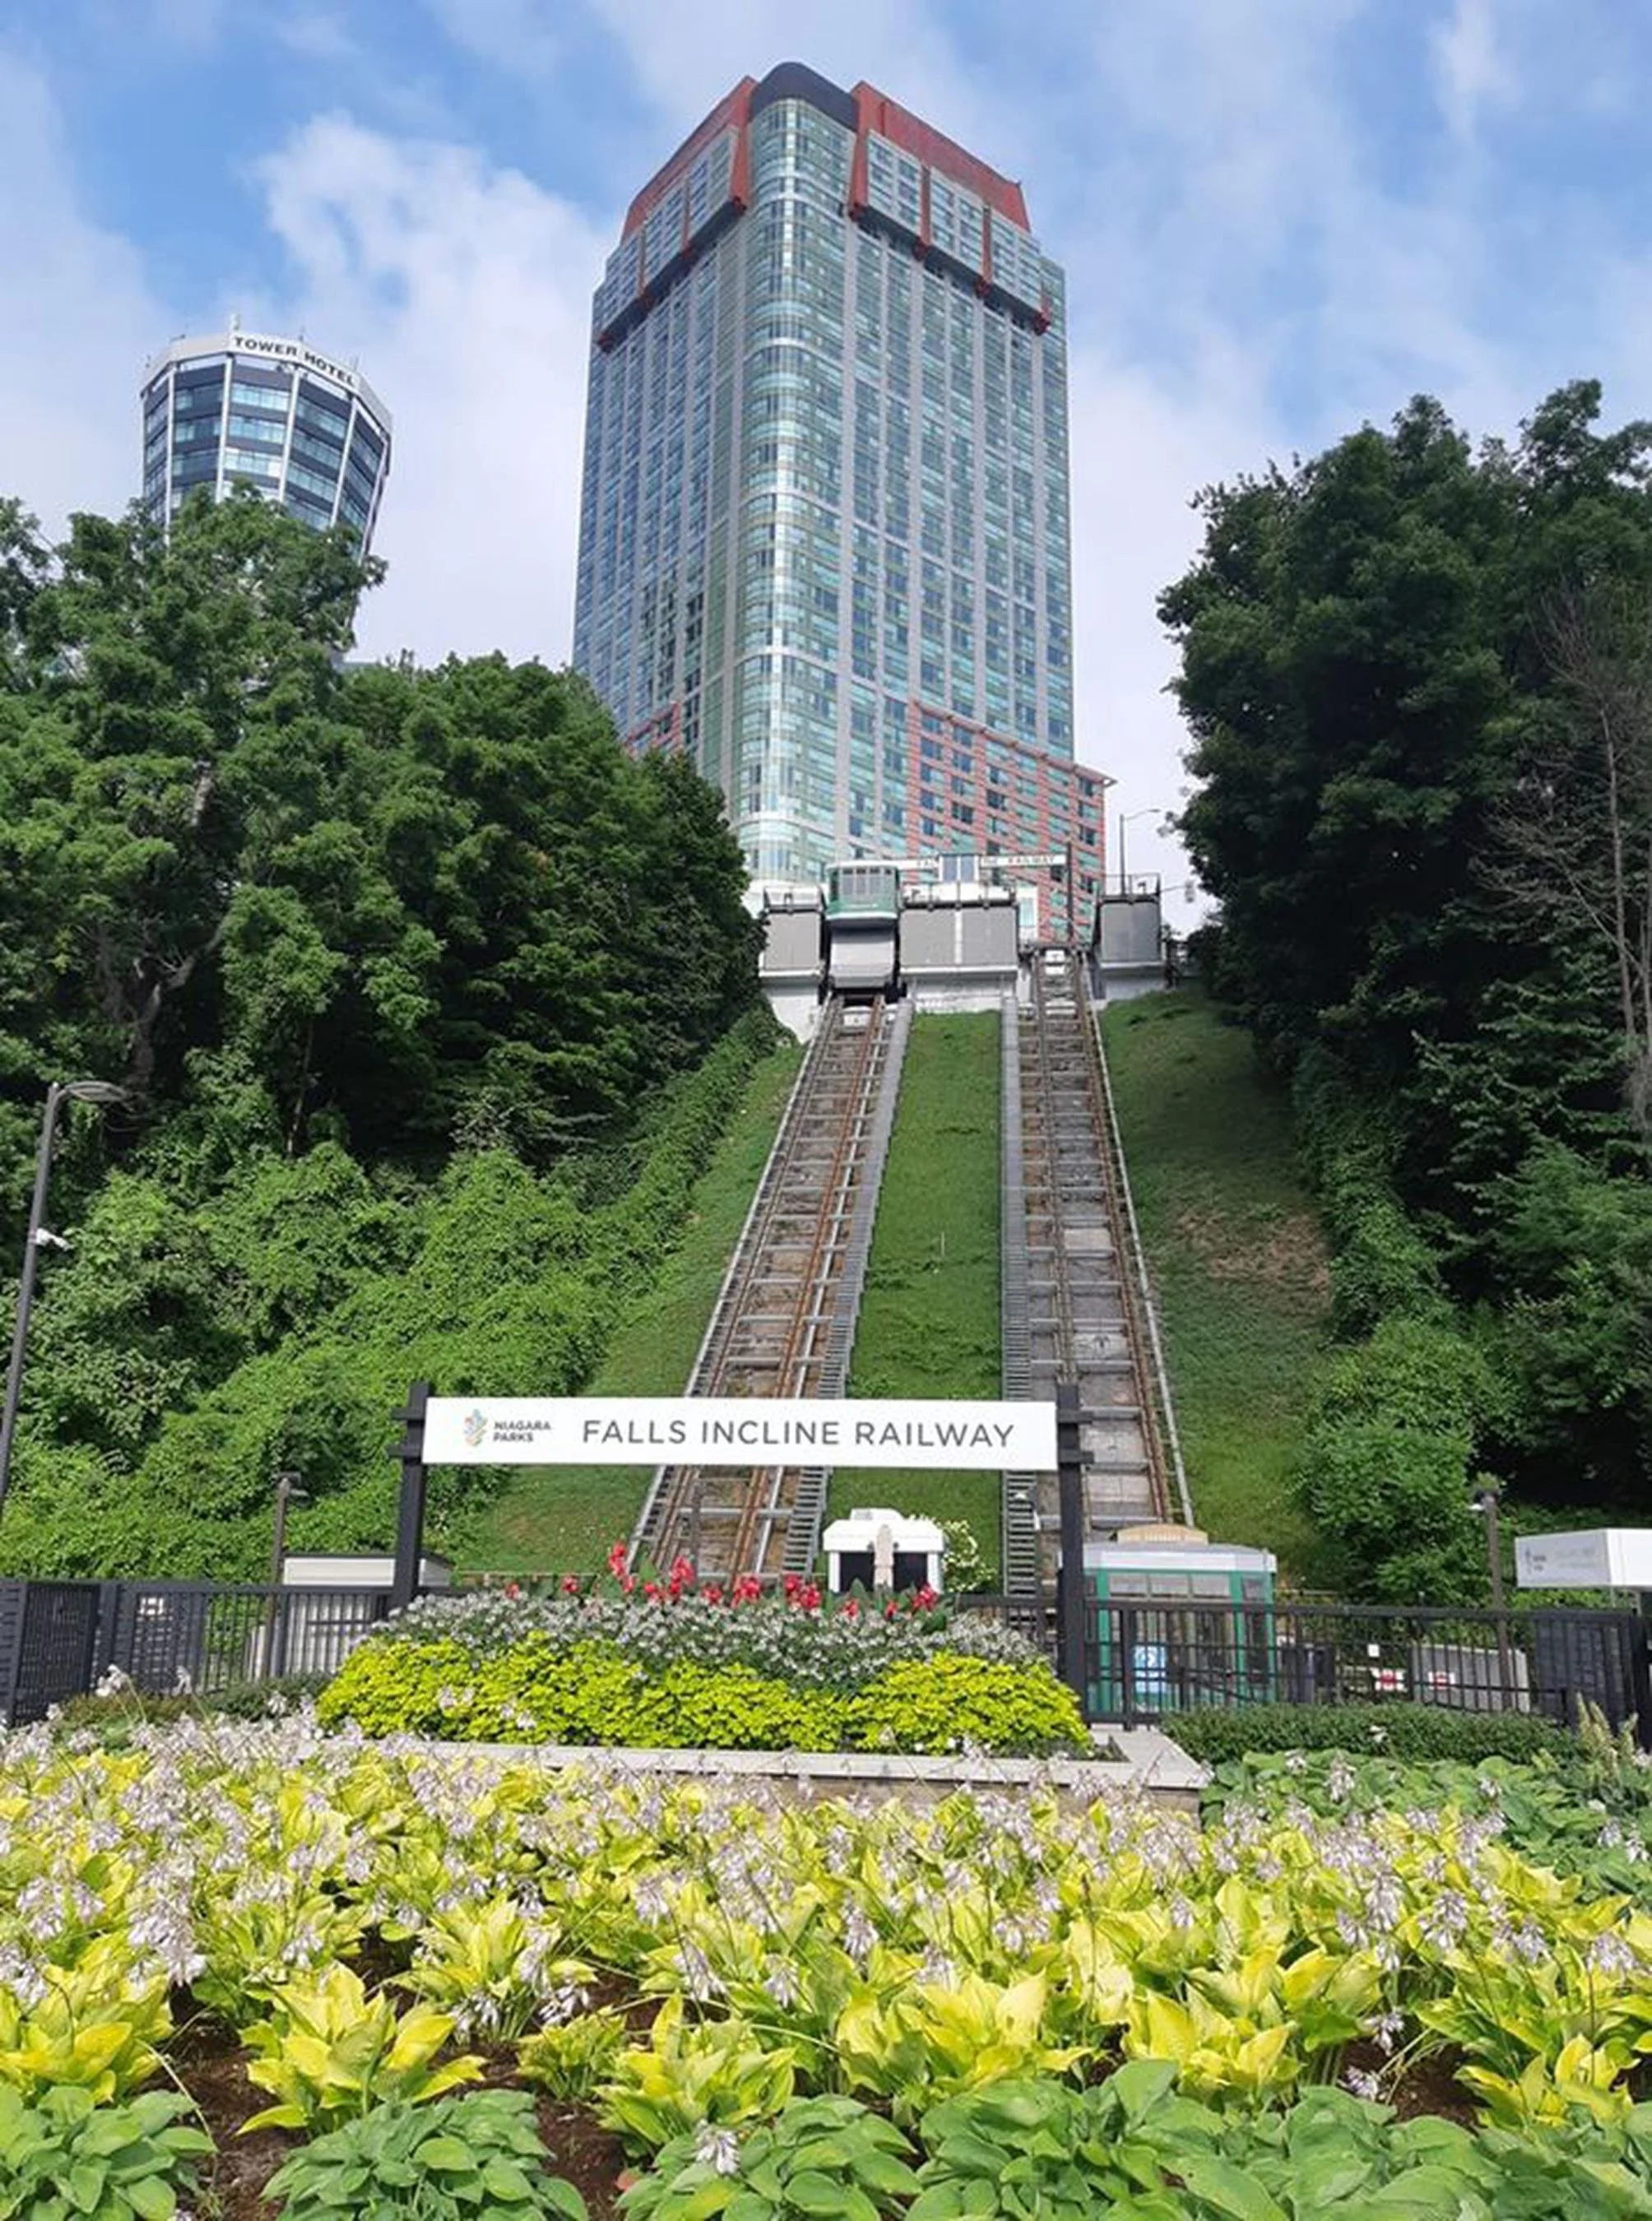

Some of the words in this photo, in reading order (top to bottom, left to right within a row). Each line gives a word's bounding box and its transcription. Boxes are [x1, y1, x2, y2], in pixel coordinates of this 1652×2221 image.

[234, 336, 297, 355] TOWER
[304, 351, 354, 385] HOTEL
[494, 1421, 552, 1430] NIAGARA
[582, 1420, 686, 1444] FALLS
[701, 1420, 841, 1445] INCLINE
[854, 1421, 1014, 1447] RAILWAY
[493, 1432, 534, 1442] PARKS
